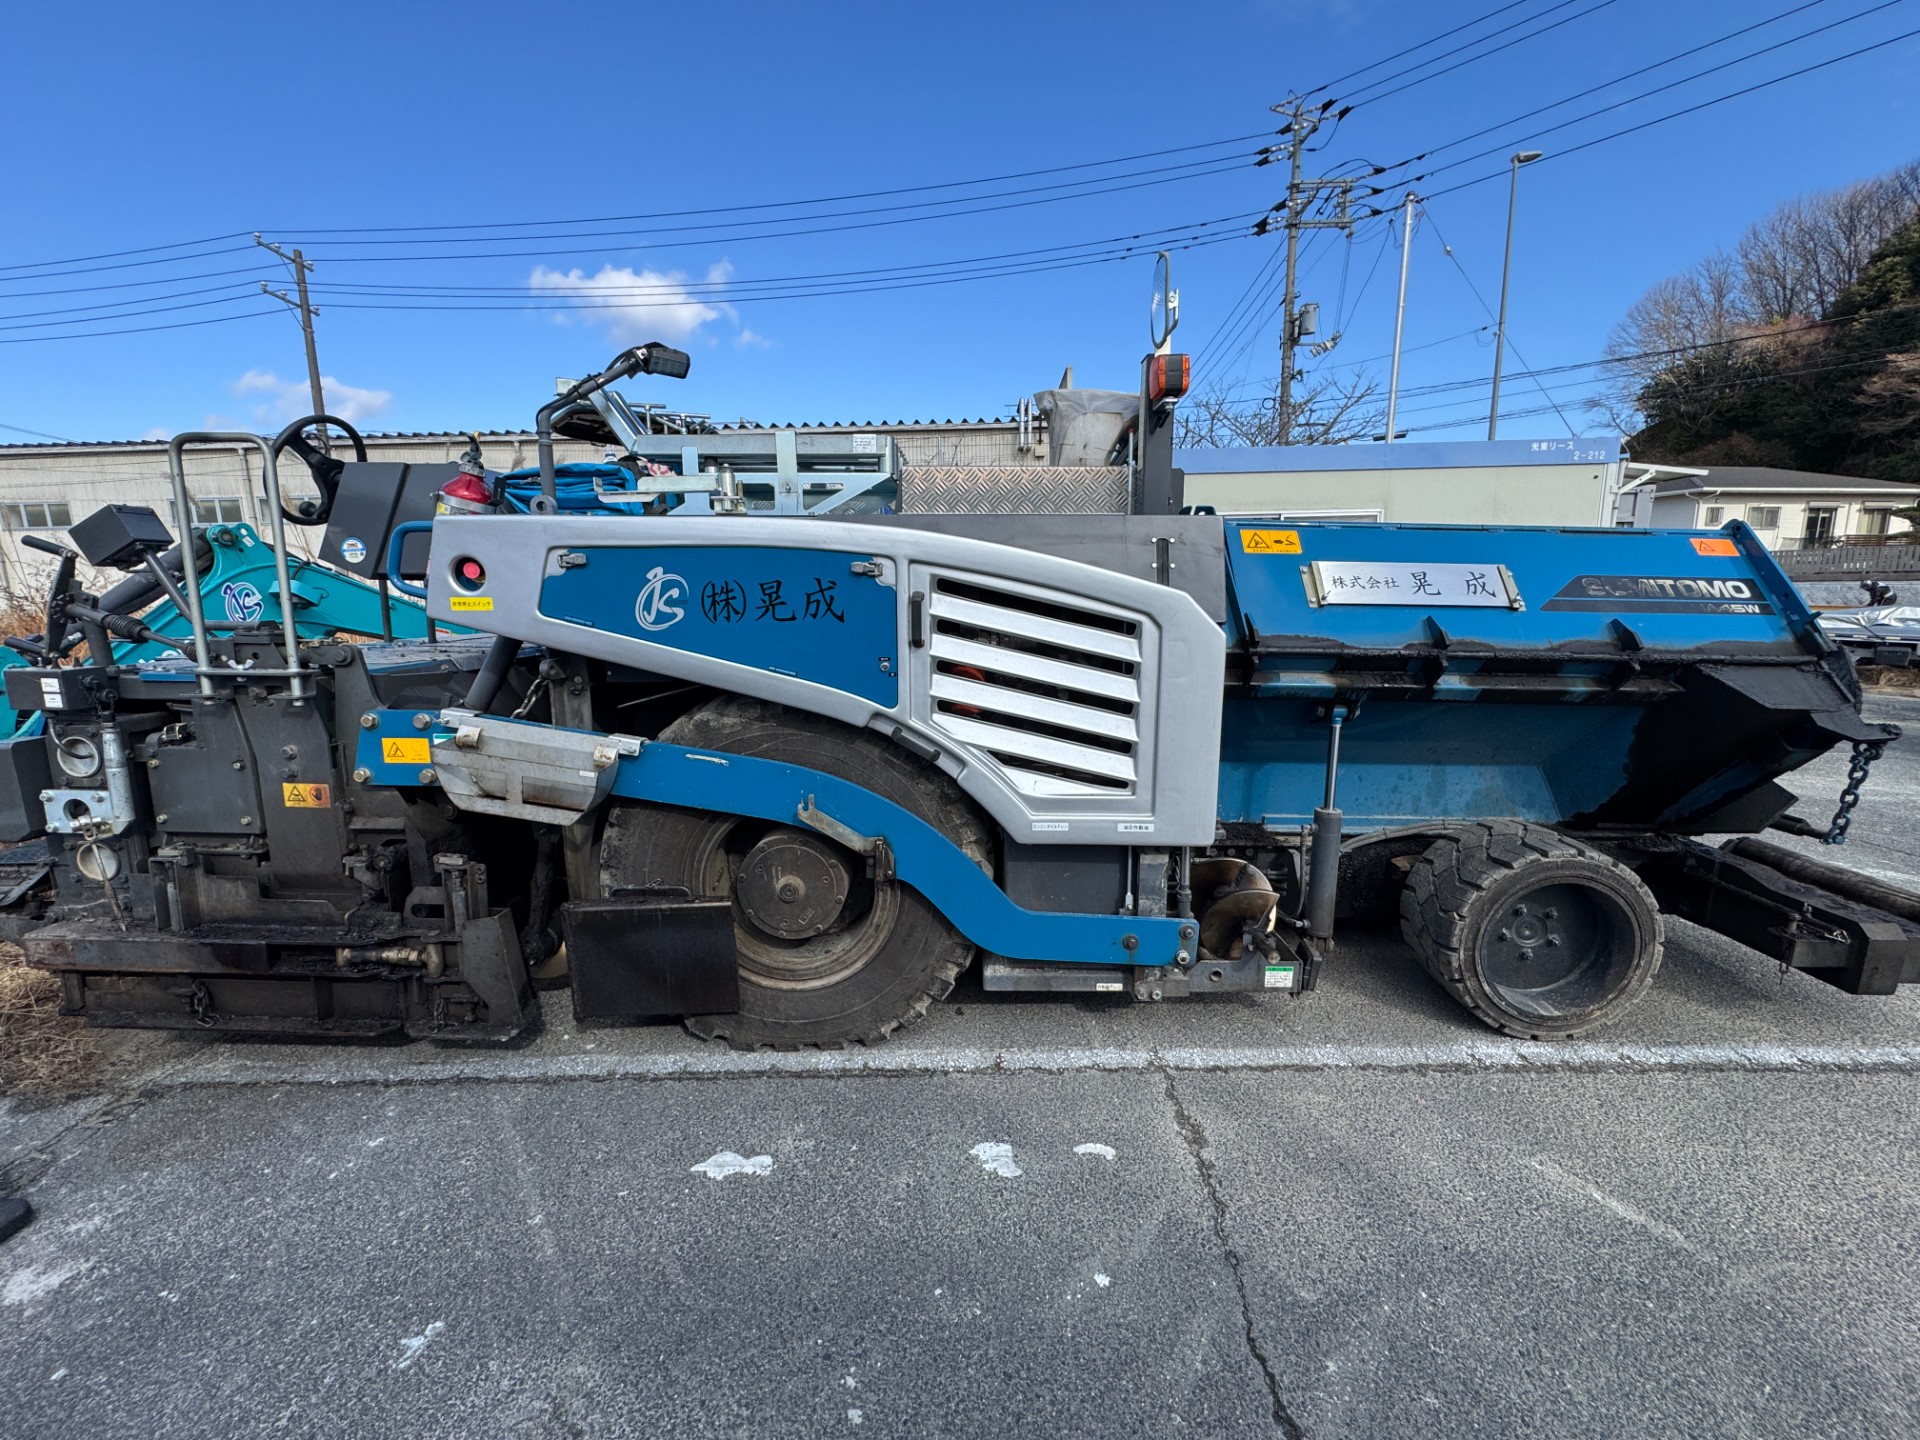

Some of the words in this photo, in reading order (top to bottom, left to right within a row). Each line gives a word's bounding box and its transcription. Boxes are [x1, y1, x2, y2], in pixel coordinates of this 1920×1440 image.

[1573, 451, 1605, 460] 2-212
[1331, 575, 1400, 590] 株式会社
